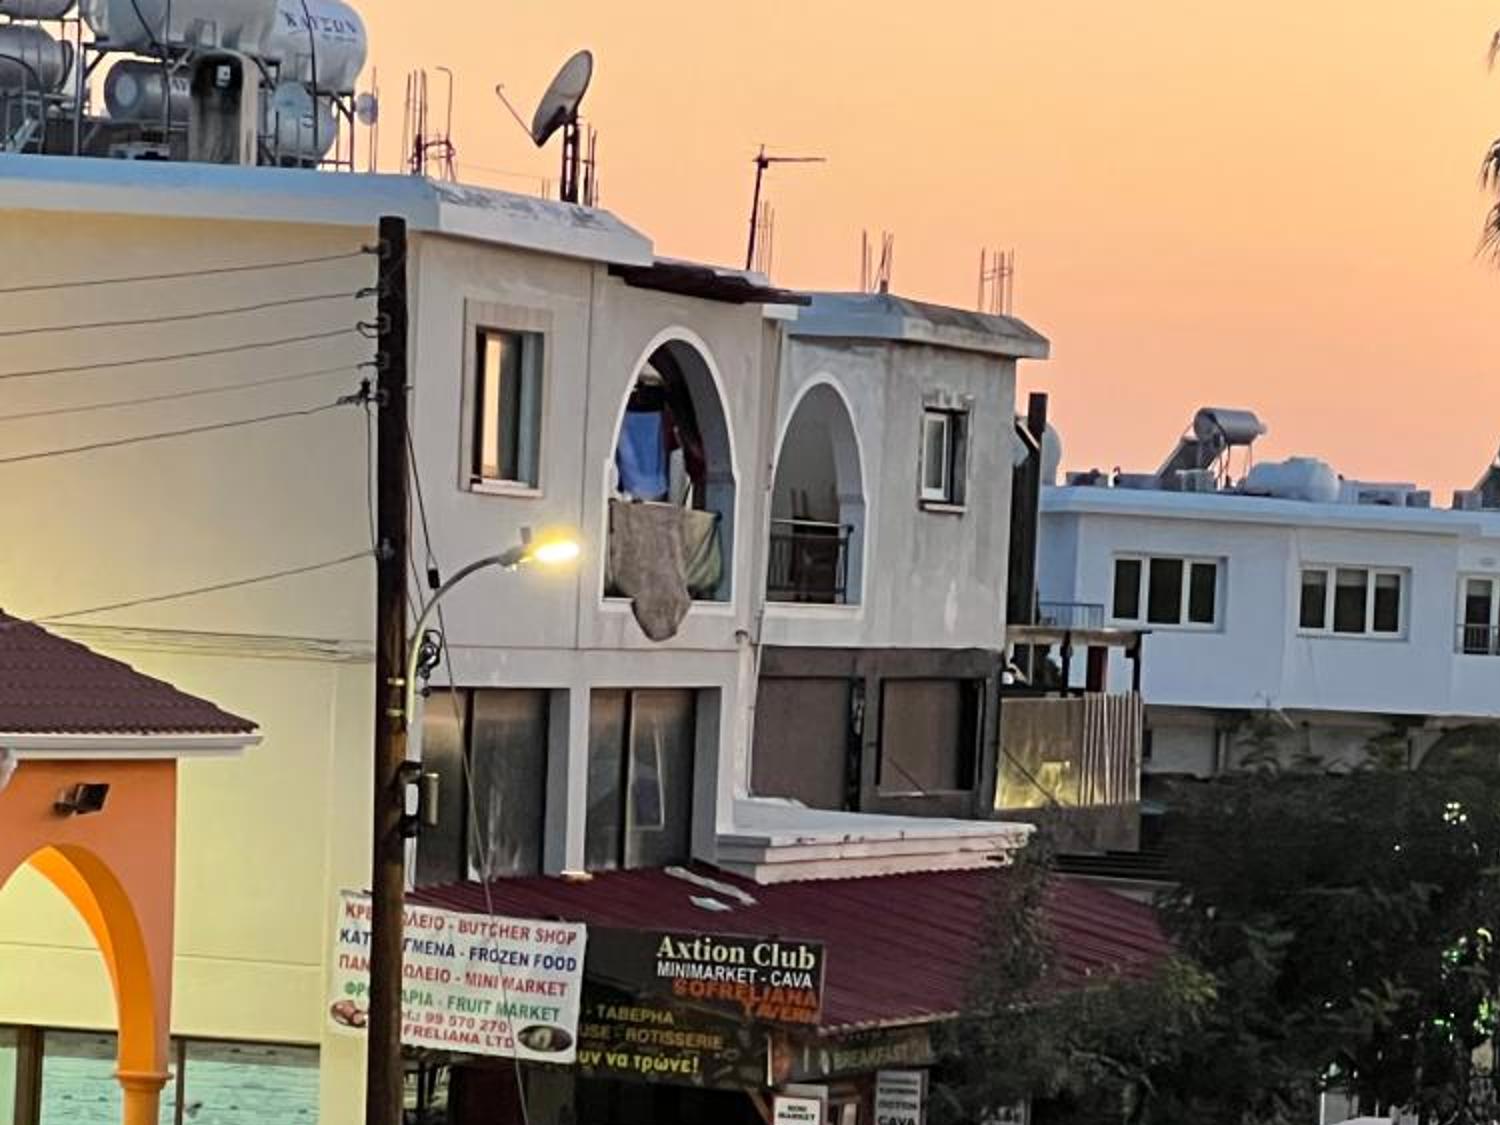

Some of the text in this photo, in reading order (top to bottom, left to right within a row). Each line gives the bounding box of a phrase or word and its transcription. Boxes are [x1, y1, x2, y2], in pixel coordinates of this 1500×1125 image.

[459, 920, 529, 942] BUTCHER
[534, 927, 577, 946] SHOP
[469, 947, 529, 967] FROZEN
[533, 954, 577, 972] FOOD
[657, 935, 816, 971] Axtion Club
[657, 961, 758, 983] MINIMARKET
[770, 970, 813, 988] CAVA
[448, 996, 491, 1015] FRUIT
[497, 1001, 561, 1022] MARKET
[404, 1023, 480, 1045] FRELIANA
